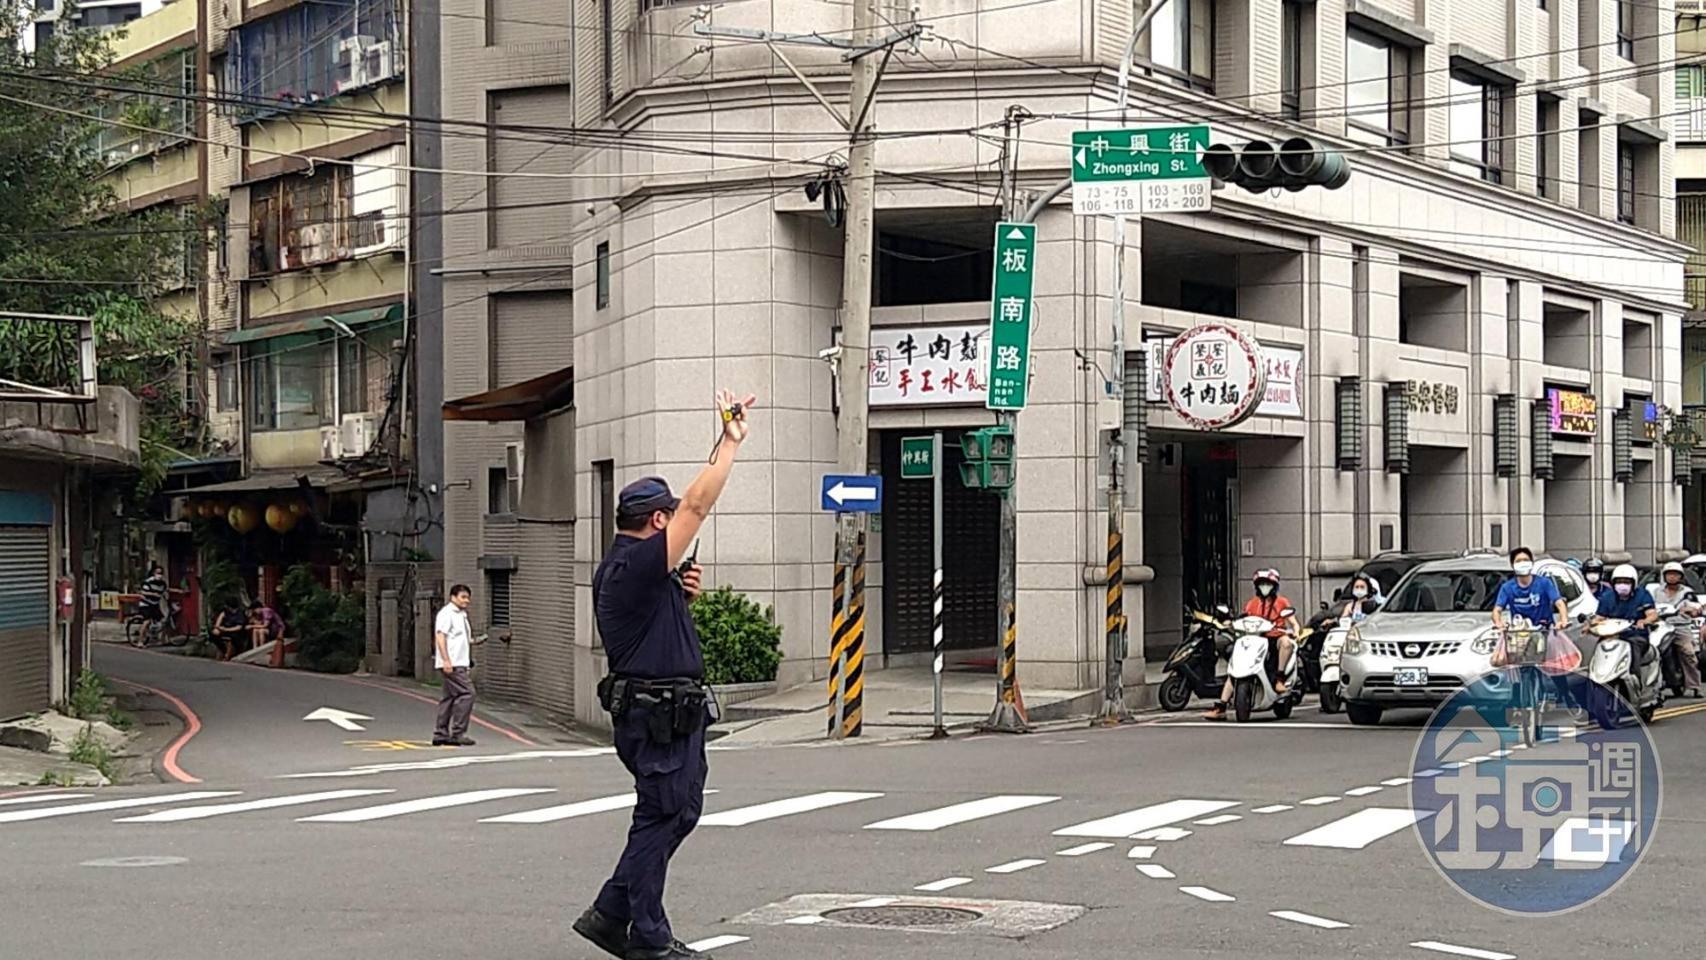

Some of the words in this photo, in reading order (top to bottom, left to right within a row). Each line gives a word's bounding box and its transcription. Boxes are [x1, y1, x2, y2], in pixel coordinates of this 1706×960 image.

[1090, 131, 1191, 158] 中興街
[1092, 160, 1159, 175] Zhongxing
[1170, 158, 1188, 173] St.
[995, 248, 1027, 371] 板南路
[994, 388, 1013, 396] nan
[1180, 382, 1239, 407] 牛肉麵
